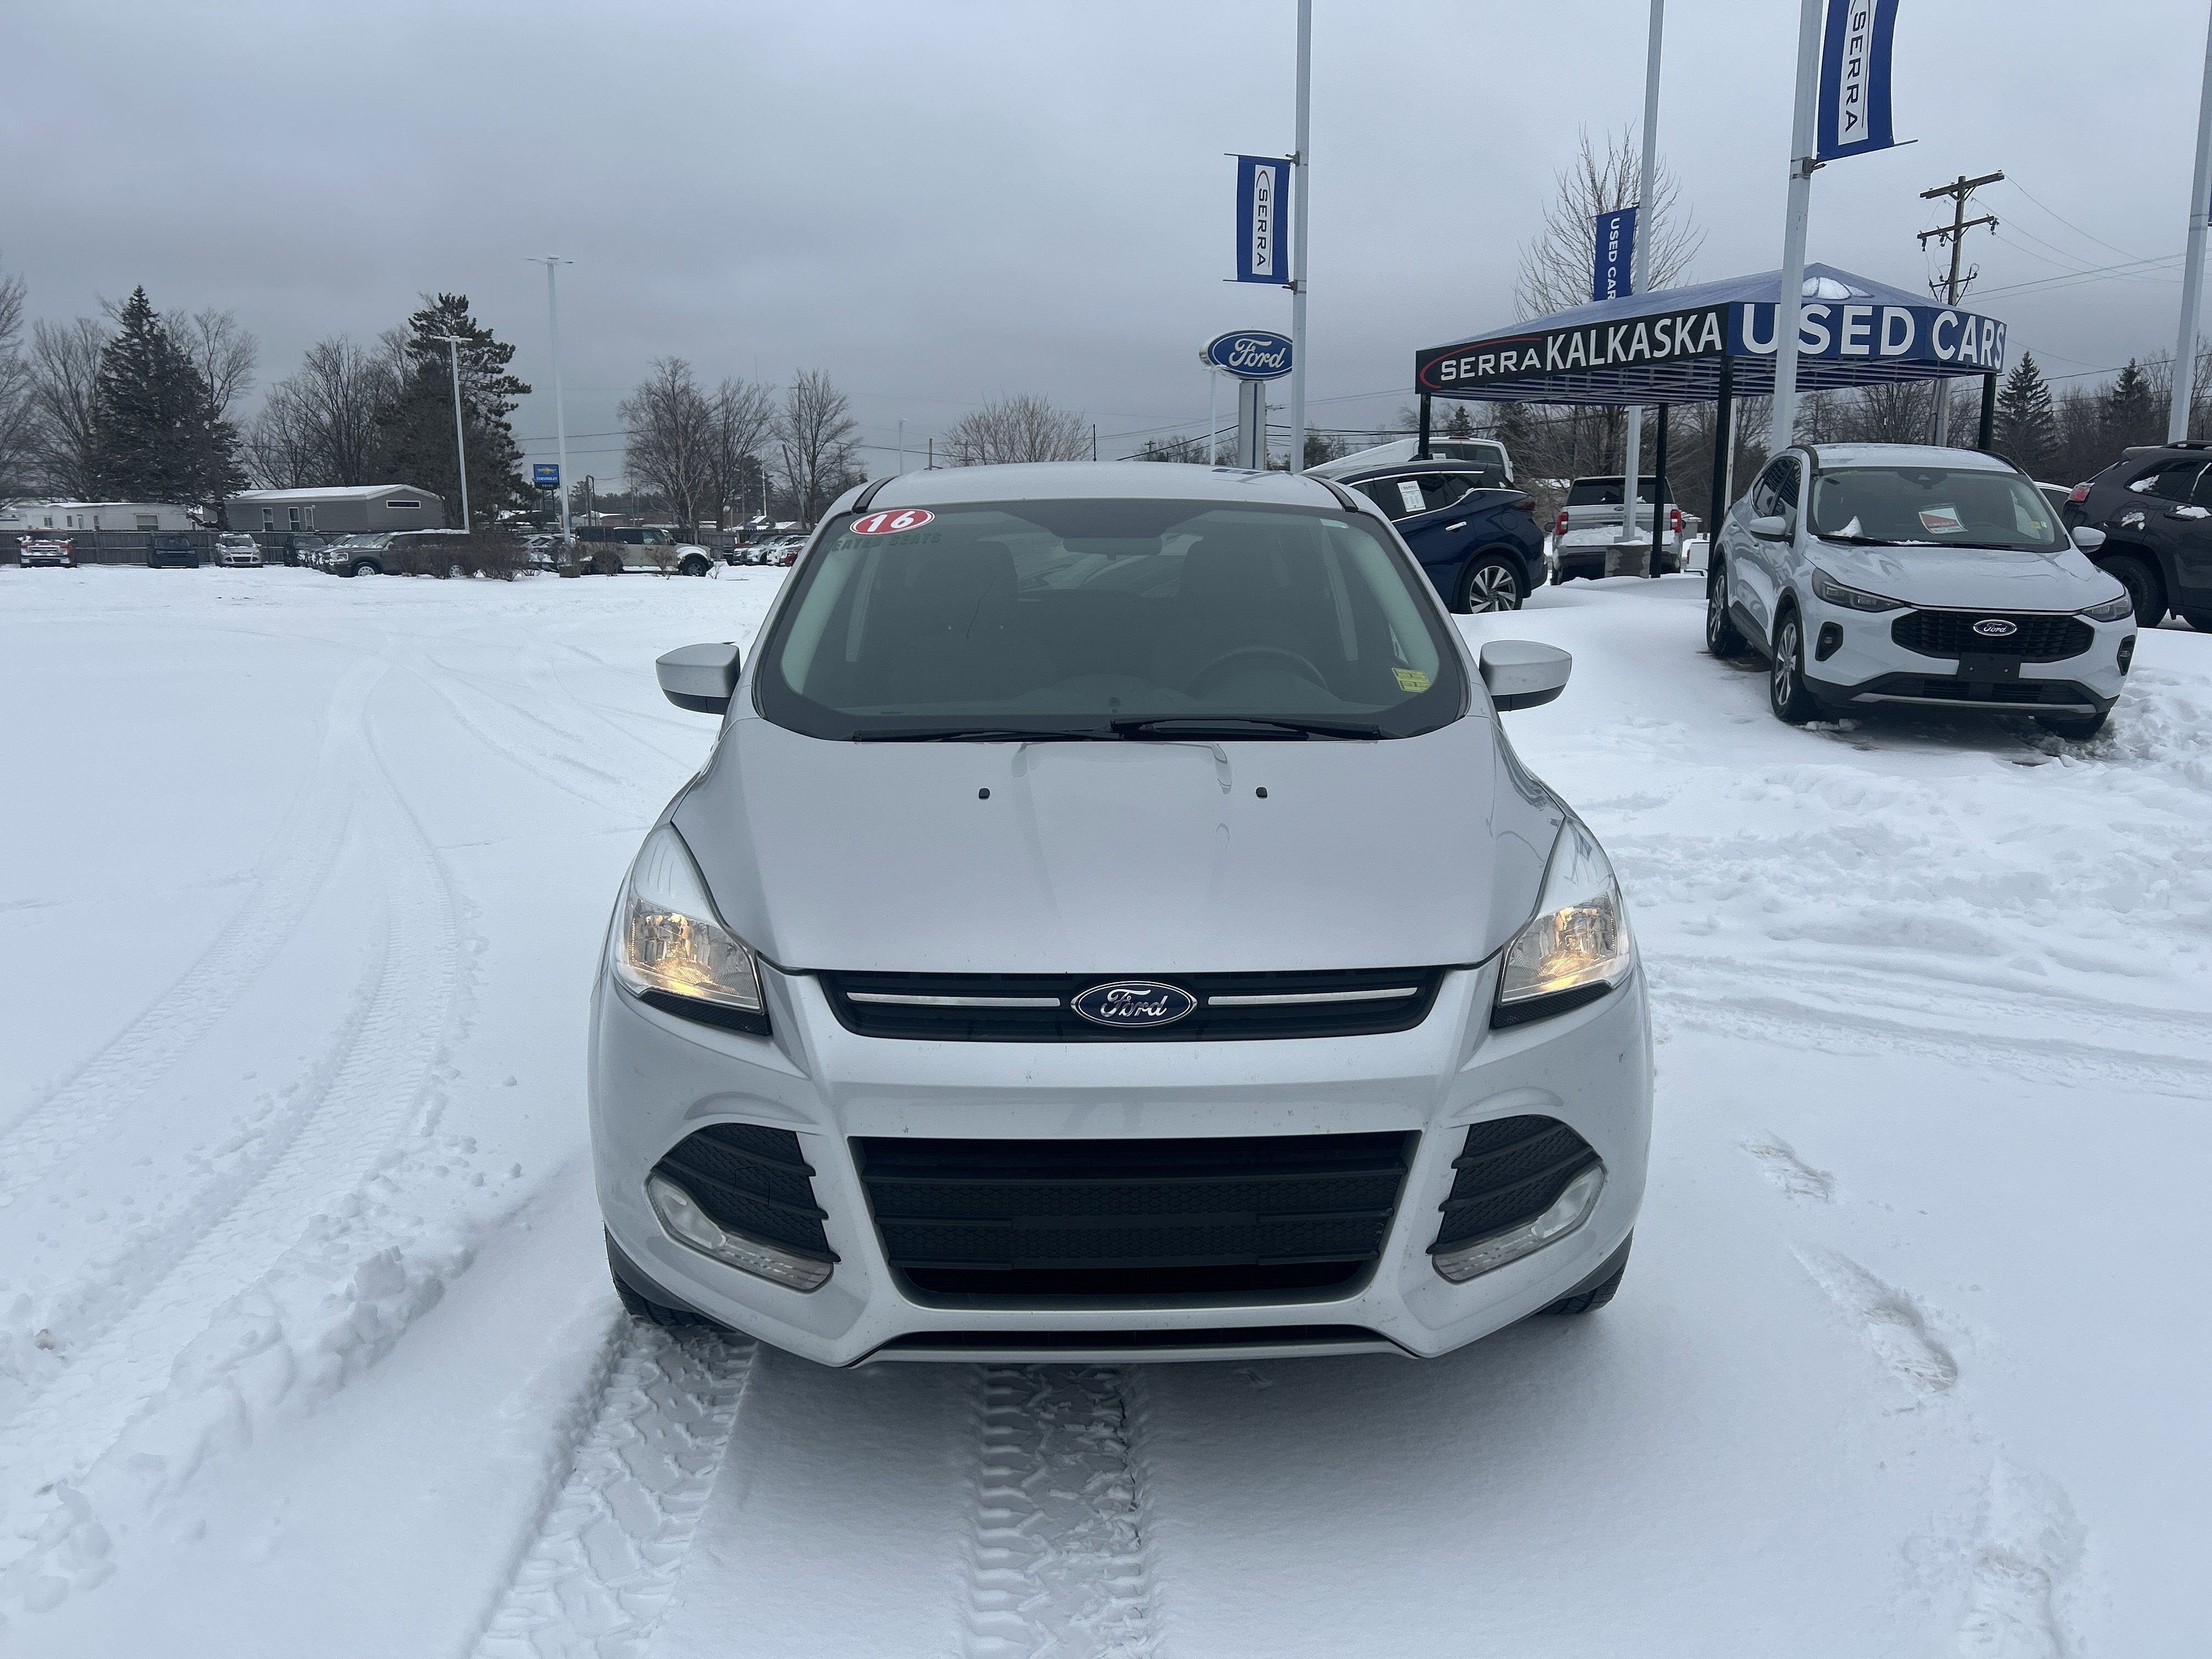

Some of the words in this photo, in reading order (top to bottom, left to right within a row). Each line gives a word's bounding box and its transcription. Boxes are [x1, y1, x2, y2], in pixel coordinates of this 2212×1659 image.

[1845, 11, 1866, 132] SERRA
[1257, 188, 1268, 267] SERRA
[1608, 217, 1620, 263] USED
[1607, 267, 1617, 300] CAR
[1440, 348, 1541, 381] SERRA
[1546, 312, 1723, 371] KALKASKA
[1742, 303, 1916, 356] USED
[1932, 311, 2004, 370] CARS
[1228, 338, 1286, 369] Ford
[867, 511, 916, 533] 16
[889, 532, 942, 546] SEATS
[1983, 623, 2008, 633] Ford
[1100, 989, 1169, 1017] Ford
